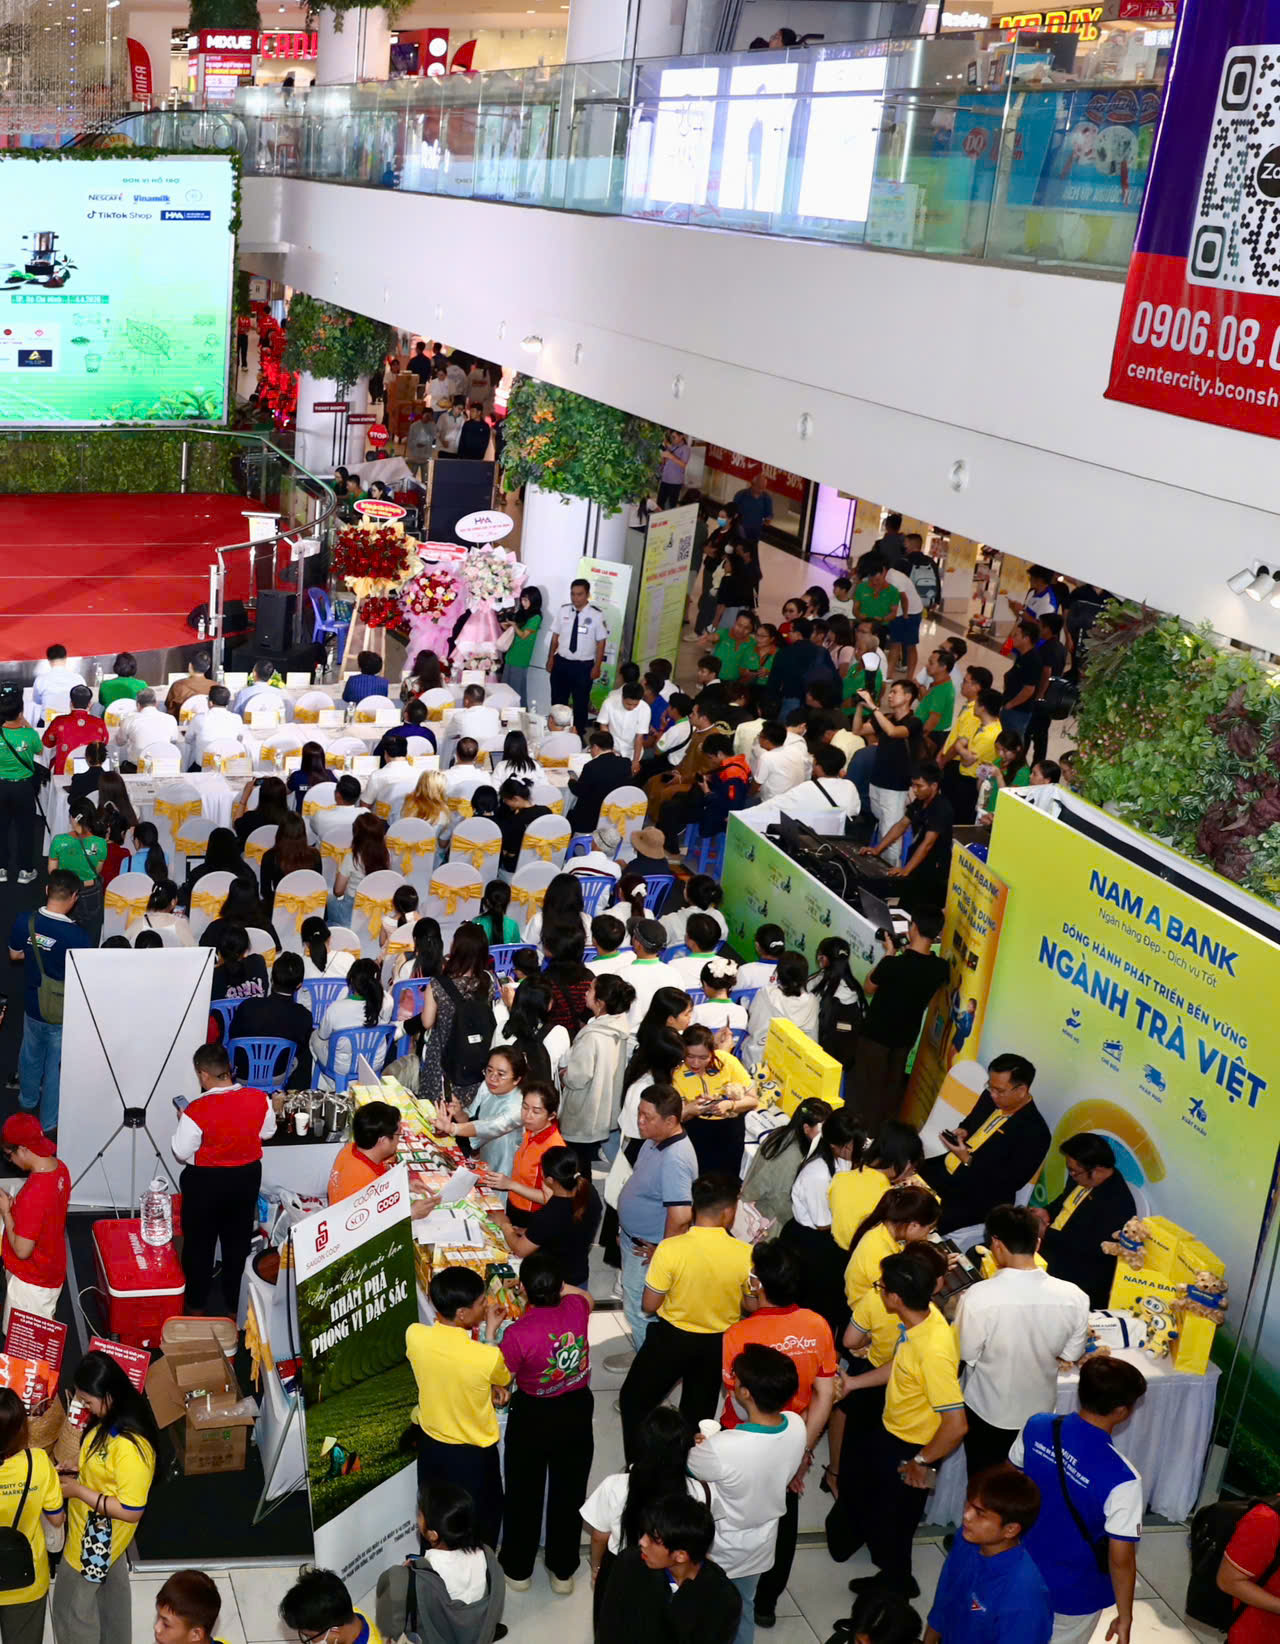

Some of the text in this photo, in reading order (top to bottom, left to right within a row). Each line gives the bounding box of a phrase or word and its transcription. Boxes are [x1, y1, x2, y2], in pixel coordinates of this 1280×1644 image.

[207, 34, 252, 50] MIXUE
[133, 194, 171, 203] Vinamilk
[98, 211, 153, 220] TikTok Shop
[369, 431, 387, 440] STOP
[1089, 869, 1240, 978] NAM A BANK
[1099, 907, 1120, 929] Ngân
[1121, 921, 1142, 944] hàng
[1143, 934, 1161, 954] Đẹp
[1167, 950, 1188, 972] Dịch
[1189, 965, 1201, 980] vụ
[1062, 921, 1248, 1050] ĐỒNG HÀNH PHÁT TRIỂN BỀN VỮNG
[1039, 935, 1267, 1109] NGÀNH TRÀ VIỆT
[377, 1192, 400, 1213] COOP
[1123, 1275, 1148, 1286] NAM
[1157, 1283, 1178, 1293] BAN
[330, 1267, 388, 1323] KHÁM PHÁ
[311, 1277, 408, 1359] PHONG VỊ ĐẶC SẮC
[558, 1348, 580, 1369] C2
